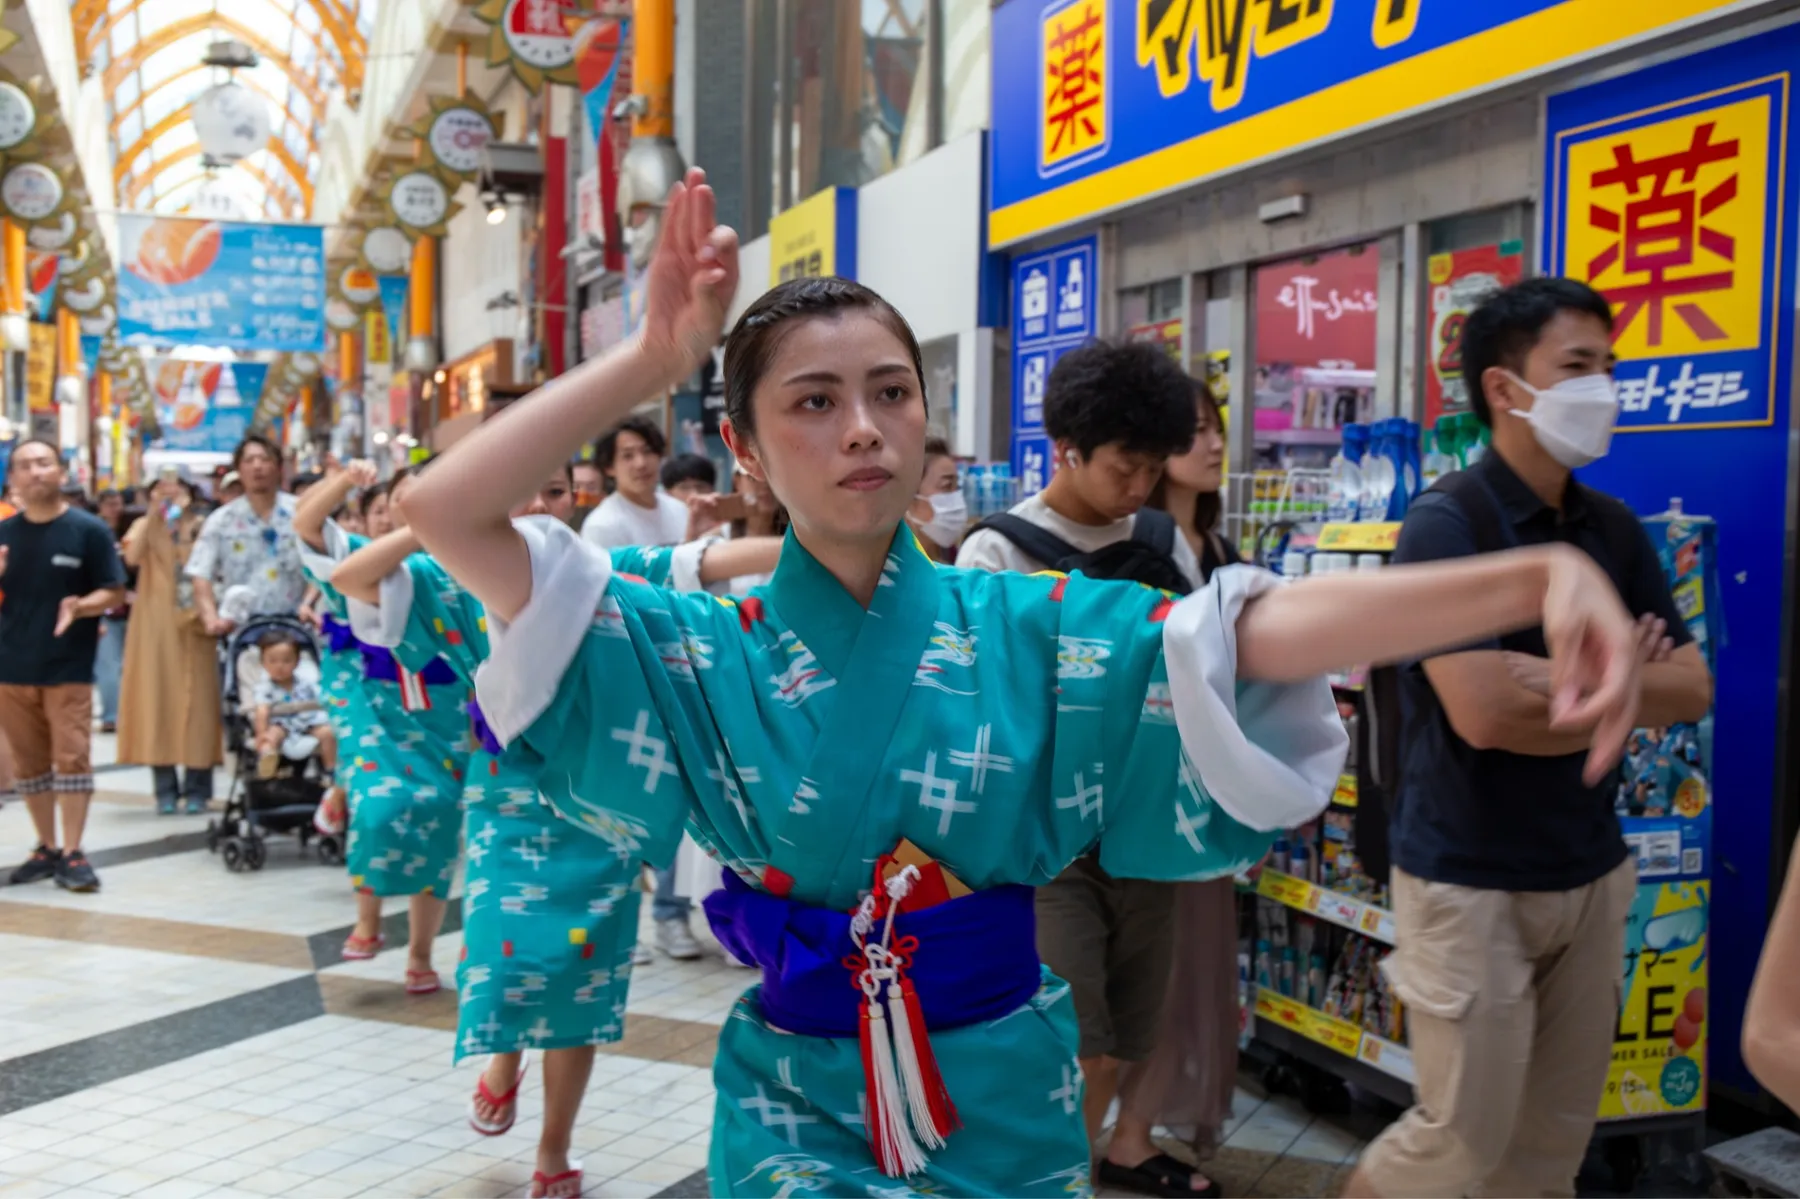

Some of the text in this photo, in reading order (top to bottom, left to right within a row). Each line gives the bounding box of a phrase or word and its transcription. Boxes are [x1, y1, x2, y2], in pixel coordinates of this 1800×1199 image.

[1049, 4, 1101, 153] 薬
[1588, 121, 1740, 347] 薬
[1616, 361, 1750, 422] モトキヨシ
[1643, 1046, 1674, 1059] SALE
